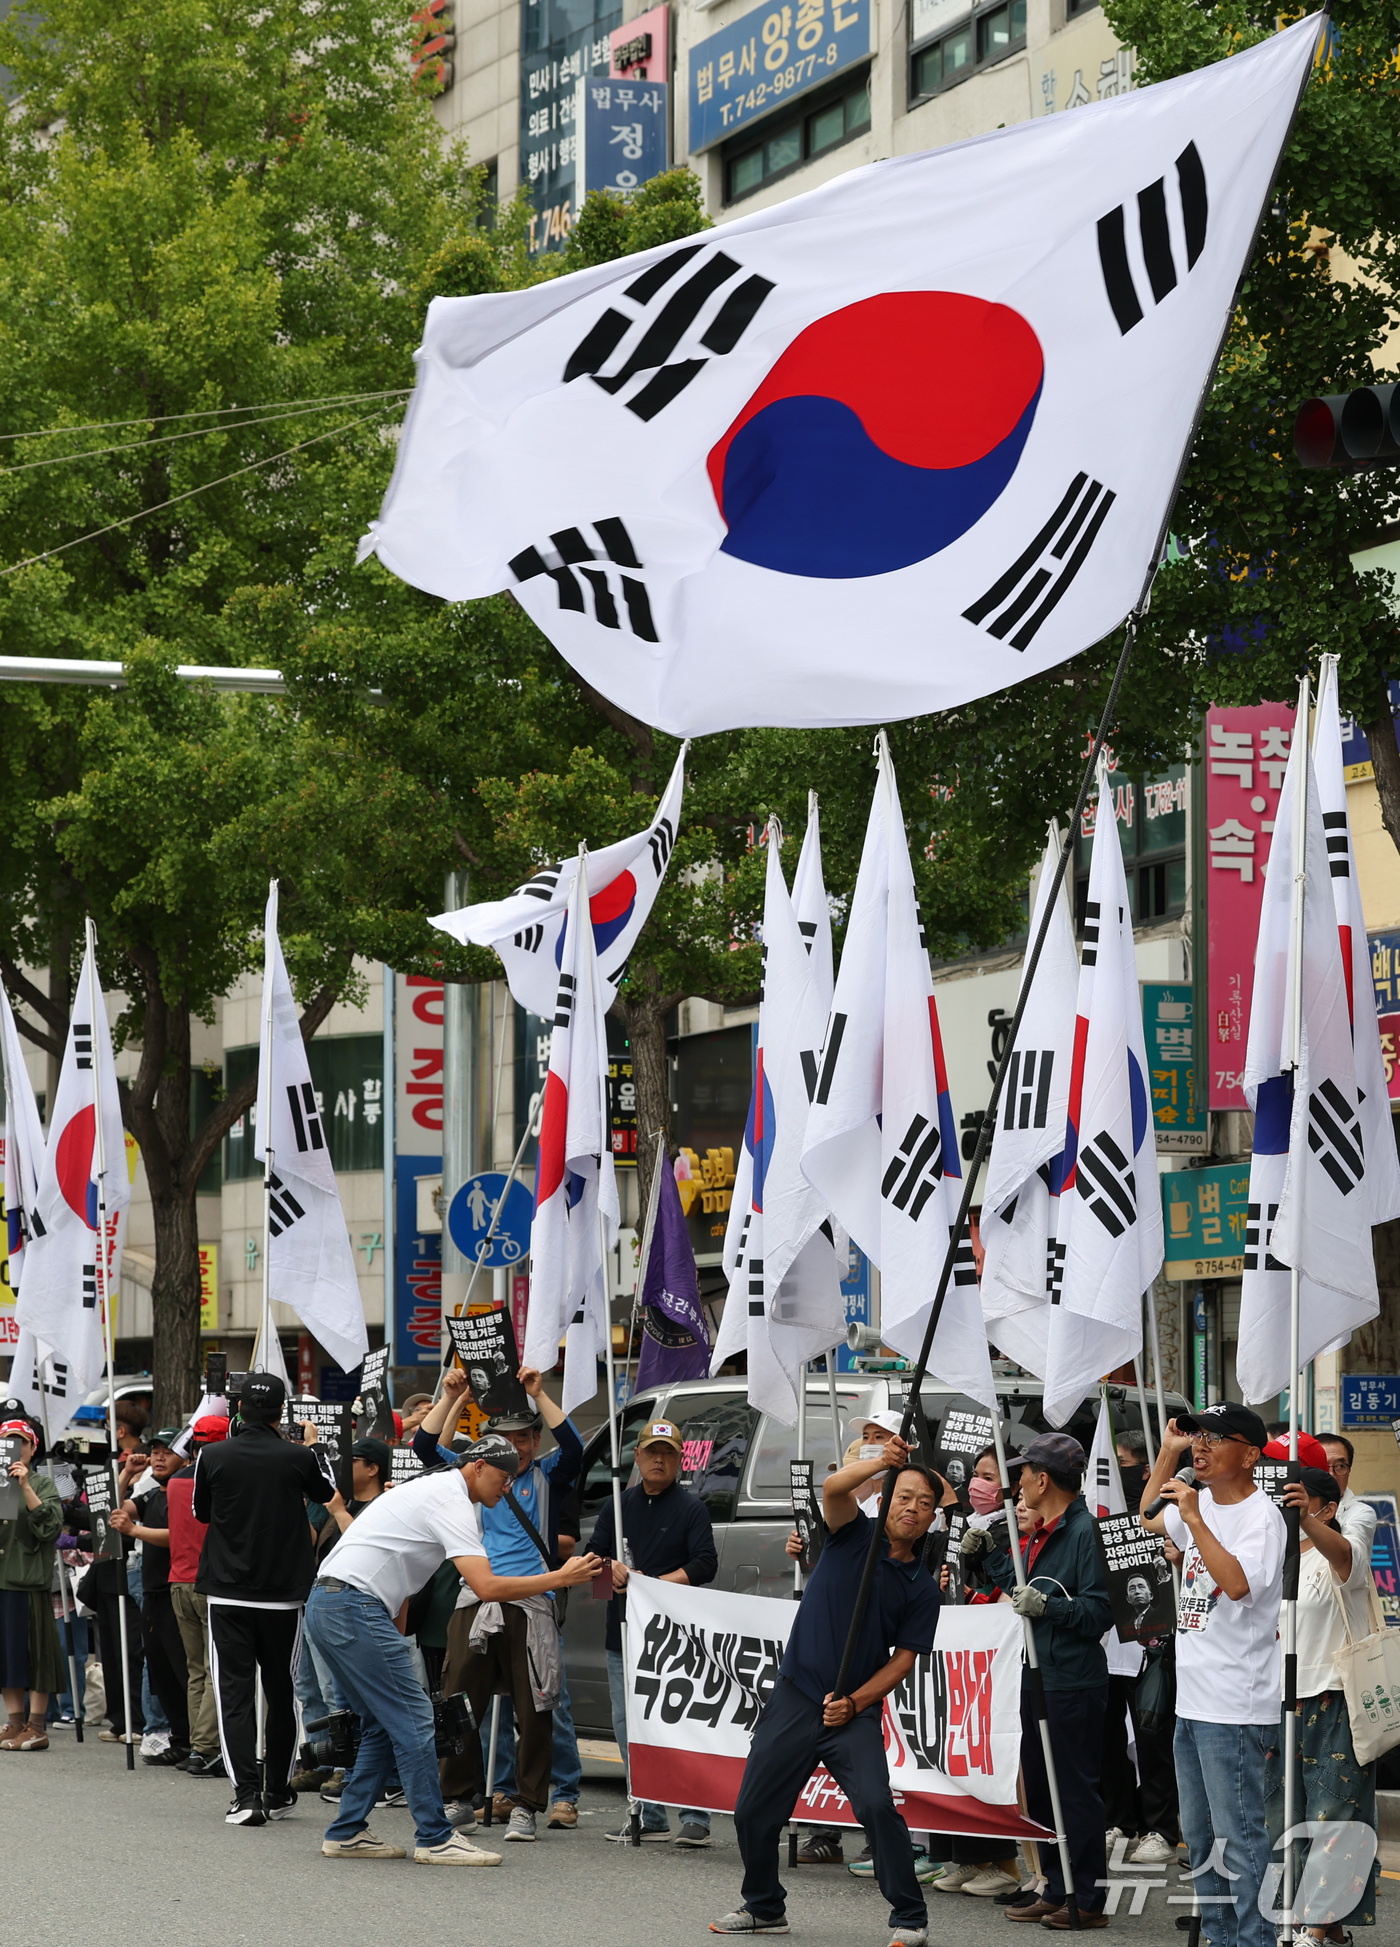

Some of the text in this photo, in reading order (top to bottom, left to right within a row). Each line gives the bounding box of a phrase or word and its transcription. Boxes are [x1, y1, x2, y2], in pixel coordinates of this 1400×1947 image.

[697, 37, 756, 105] 법무사
[529, 65, 550, 99] 민사
[720, 42, 838, 126] T.742-9877~8
[591, 86, 663, 114] 법무사
[528, 106, 550, 138] 의료
[528, 146, 549, 181] 형사
[1155, 1134, 1203, 1145] 54-4790
[1205, 1258, 1244, 1274] 754-47
[449, 1312, 503, 1330] 박정희 대통령
[455, 1335, 505, 1351] 자유대한민국
[1360, 1381, 1386, 1391] 법무사
[292, 1404, 343, 1415] 박정희 대통령
[1349, 1393, 1397, 1410] 김동기
[949, 1411, 975, 1424] 박정희
[945, 1420, 991, 1436] 동상 철거는
[942, 1430, 994, 1446] 자유대한민국
[1253, 1466, 1288, 1479] 대통령
[1099, 1518, 1131, 1533] 박정희
[1102, 1531, 1124, 1546] 동상
[1105, 1537, 1165, 1559] 자유대한민국
[1107, 1552, 1153, 1572] 말살이다!
[946, 1648, 999, 1777] 반대
